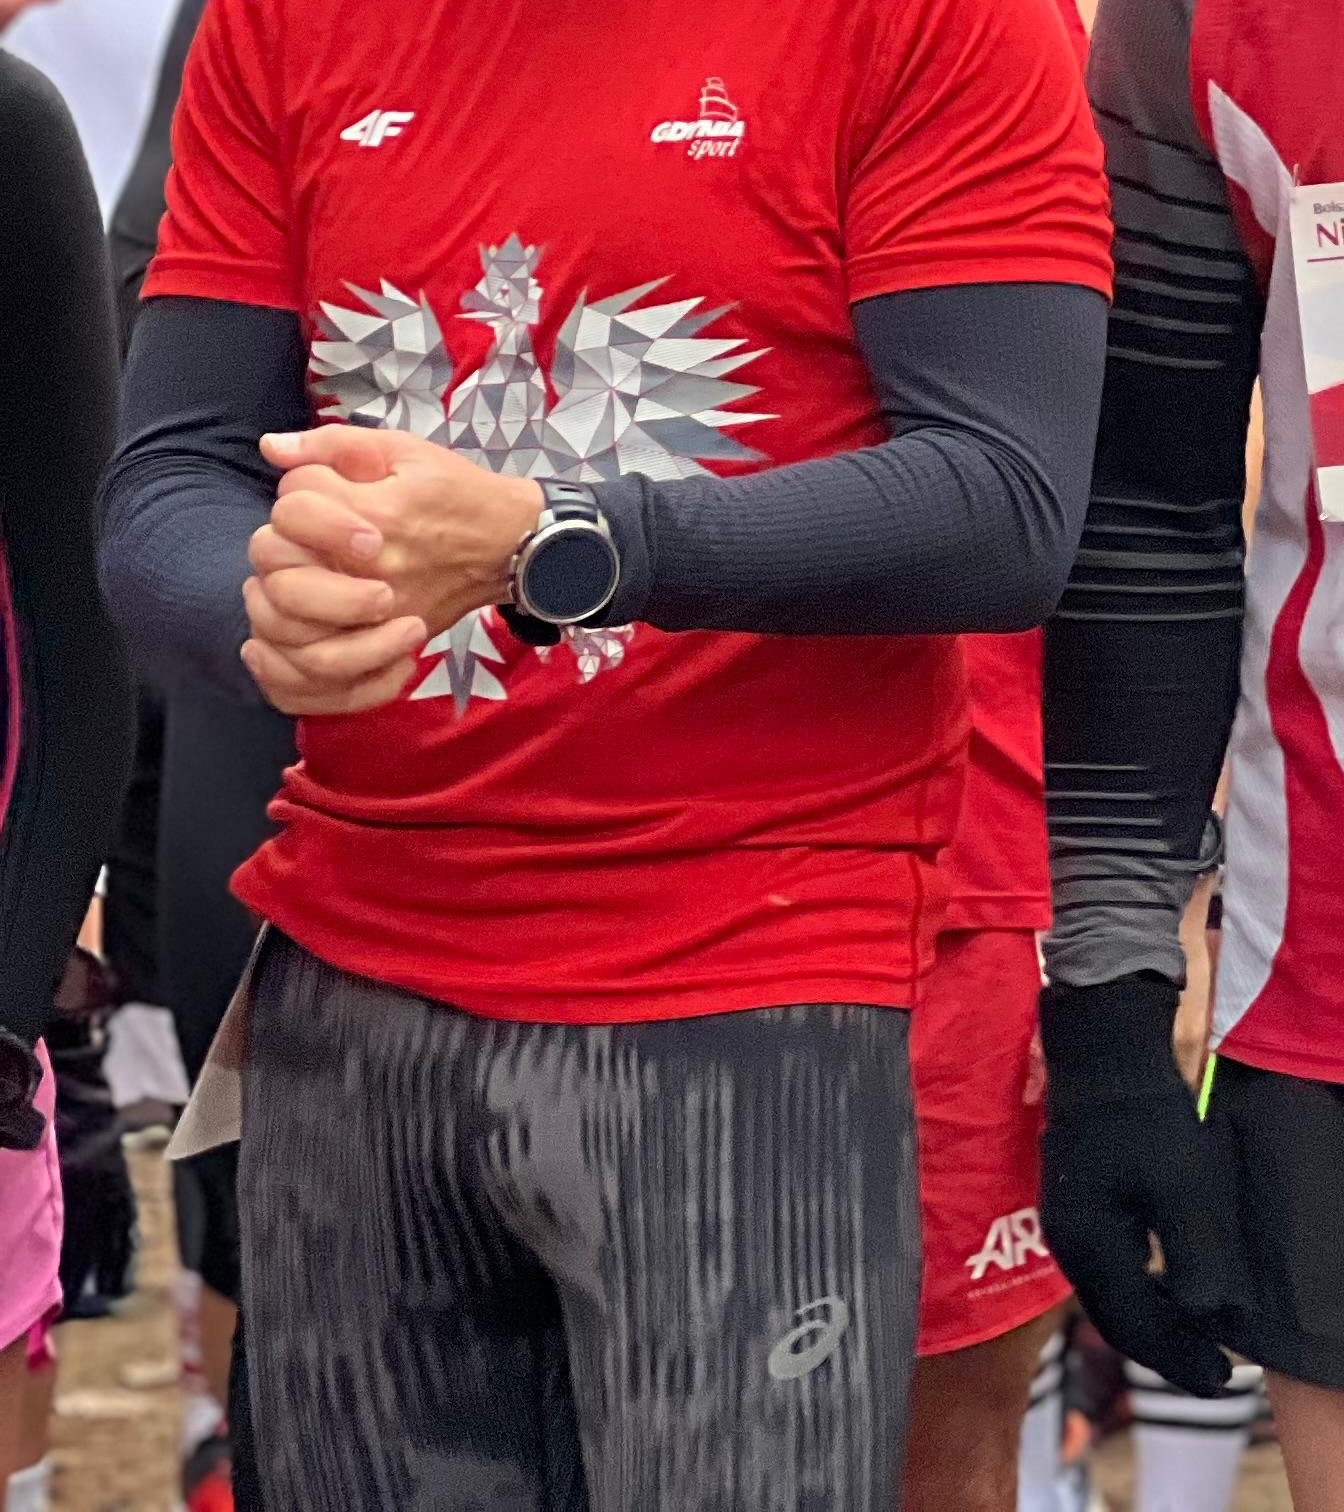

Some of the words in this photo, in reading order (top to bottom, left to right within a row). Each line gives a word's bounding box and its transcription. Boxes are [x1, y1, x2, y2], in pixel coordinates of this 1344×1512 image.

[339, 108, 416, 148] 4F
[650, 119, 746, 145] GDYNIA
[686, 138, 739, 161] sport
